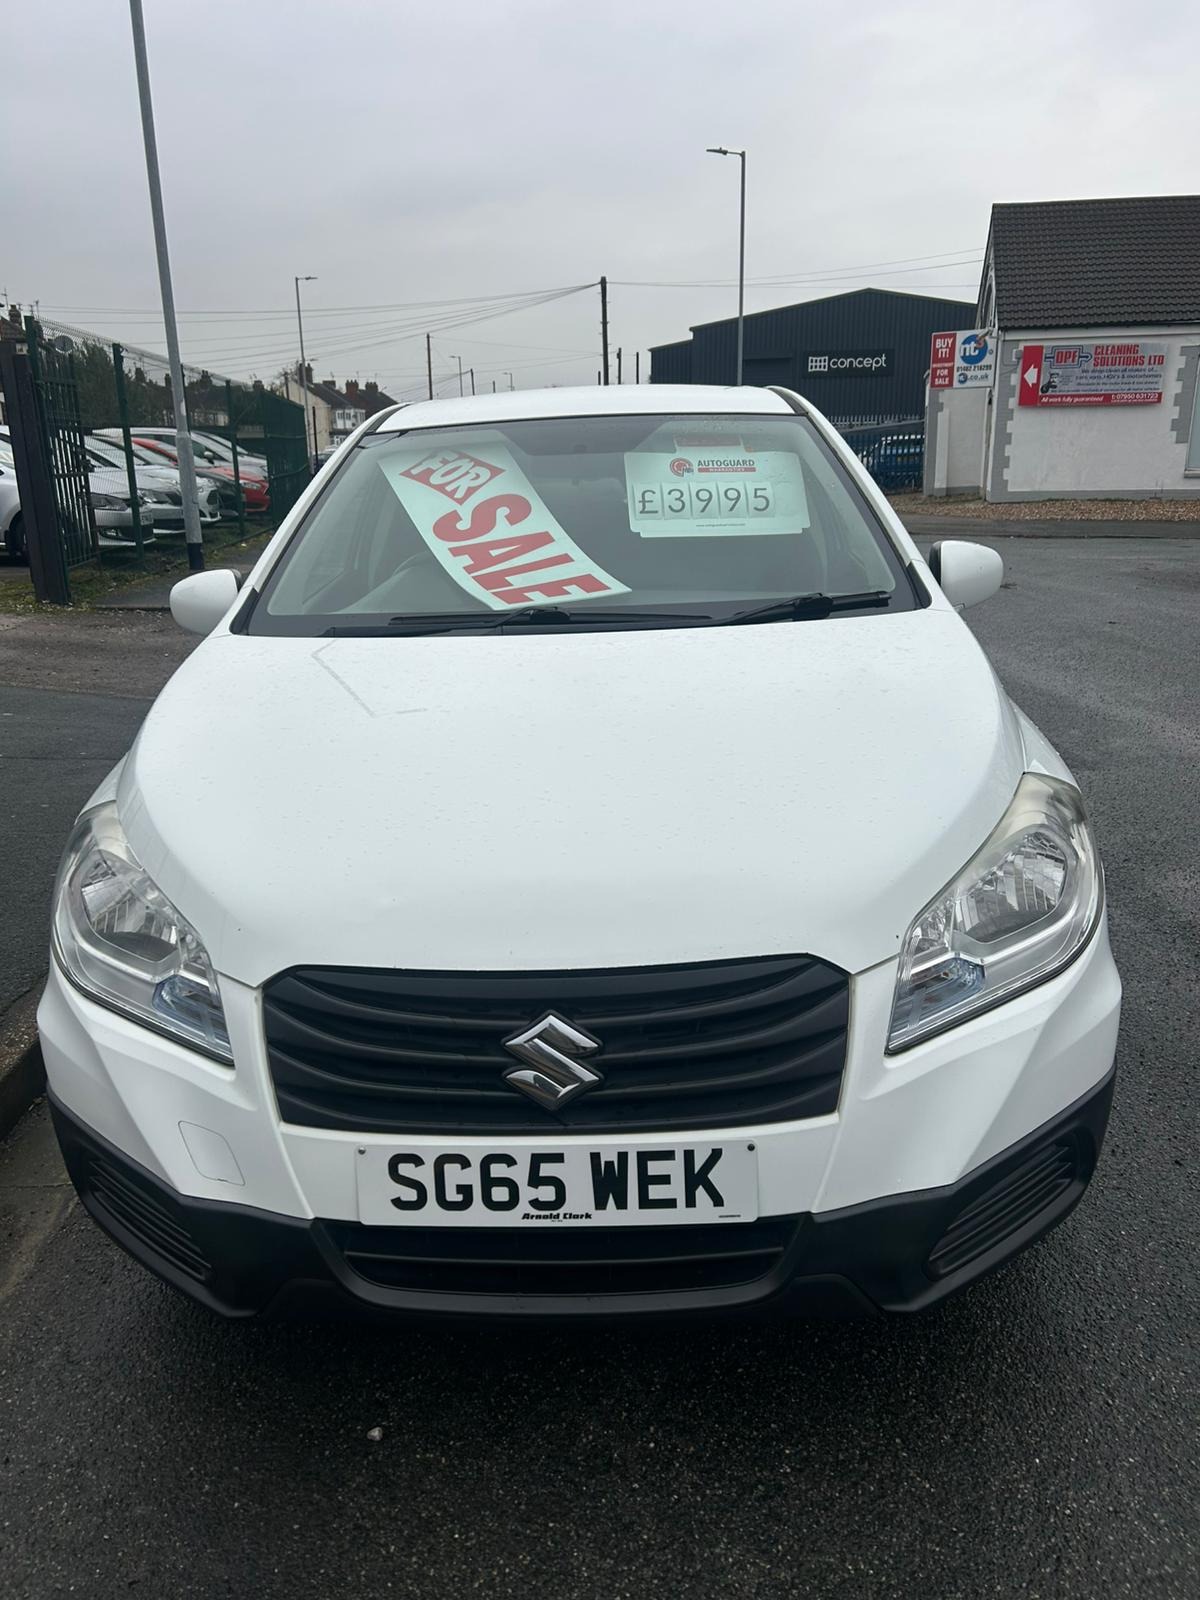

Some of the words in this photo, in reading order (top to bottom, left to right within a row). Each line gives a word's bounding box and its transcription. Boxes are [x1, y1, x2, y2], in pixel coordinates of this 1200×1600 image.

[936, 338, 953, 348] BUY
[1094, 344, 1139, 355] CLEANING
[938, 348, 949, 358] IT!
[1056, 350, 1078, 363] DPF
[829, 353, 887, 371] concept
[1093, 355, 1145, 367] SOLUTIONS
[1147, 354, 1165, 366] LTD
[697, 459, 755, 467] AUTOGUARD
[410, 449, 491, 499] FOR
[638, 487, 771, 515] £3995
[433, 493, 612, 605] SALE
[387, 1152, 567, 1212] SG65
[589, 1148, 725, 1211] WEK
[521, 1212, 560, 1220] Arnold
[562, 1212, 592, 1220] Clark
